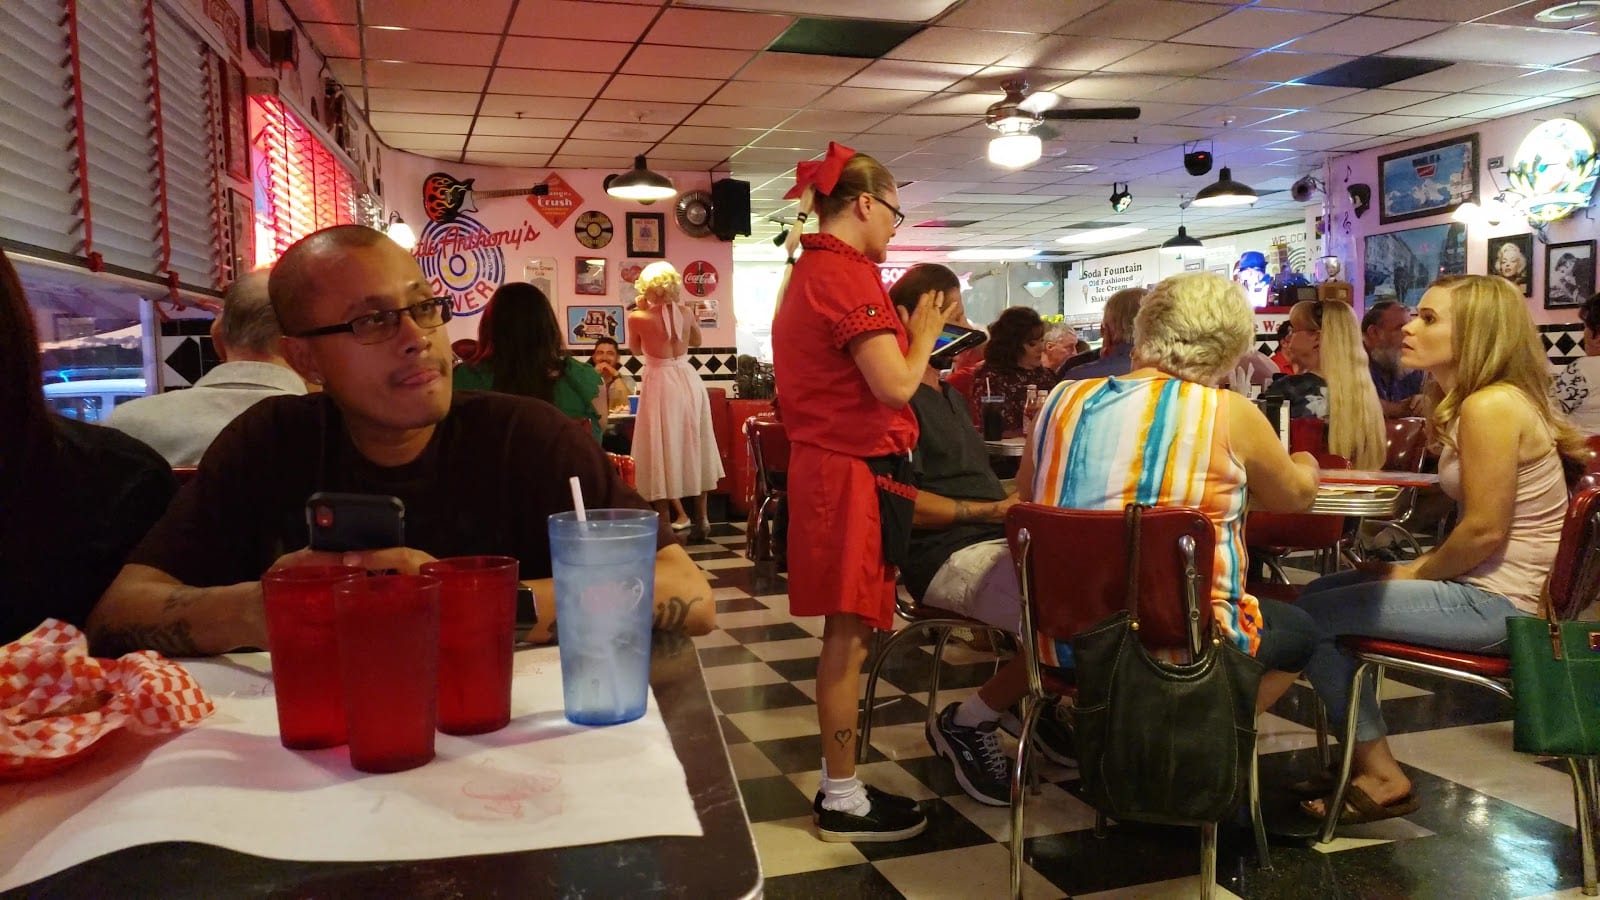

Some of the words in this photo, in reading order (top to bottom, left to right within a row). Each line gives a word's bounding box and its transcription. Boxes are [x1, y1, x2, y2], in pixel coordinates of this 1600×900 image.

[537, 196, 573, 207] Crush
[438, 220, 541, 259] Anthony's
[1271, 232, 1307, 246] WELCO
[1083, 269, 1102, 280] Soda
[1104, 262, 1143, 277] Fountain
[1101, 275, 1134, 286] Fashioned
[1106, 284, 1128, 292] Cream
